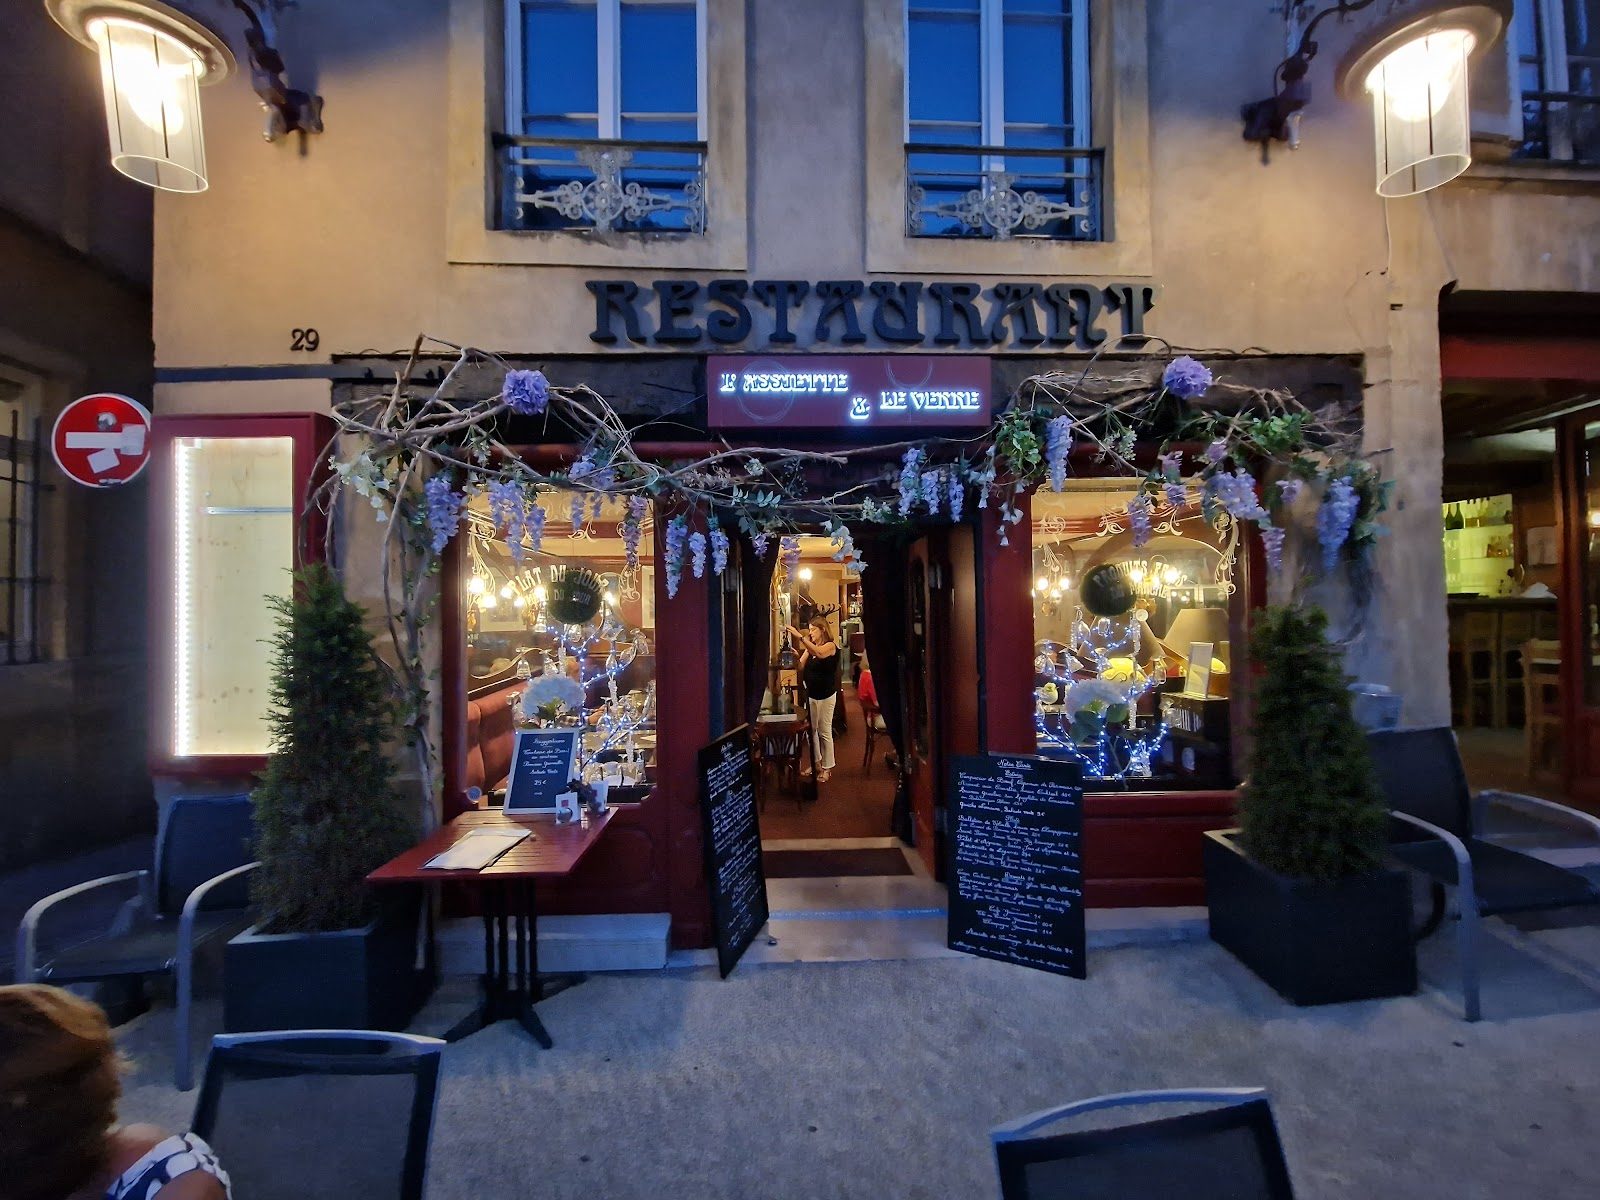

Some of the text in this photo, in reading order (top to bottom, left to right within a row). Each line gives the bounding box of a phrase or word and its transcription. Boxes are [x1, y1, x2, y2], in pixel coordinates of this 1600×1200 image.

[585, 279, 1160, 347] RESTAURANT
[290, 328, 319, 351] 29
[742, 372, 849, 393] ASSIETTE
[850, 396, 871, 420] &
[880, 391, 907, 410] LE
[551, 565, 566, 583] DU
